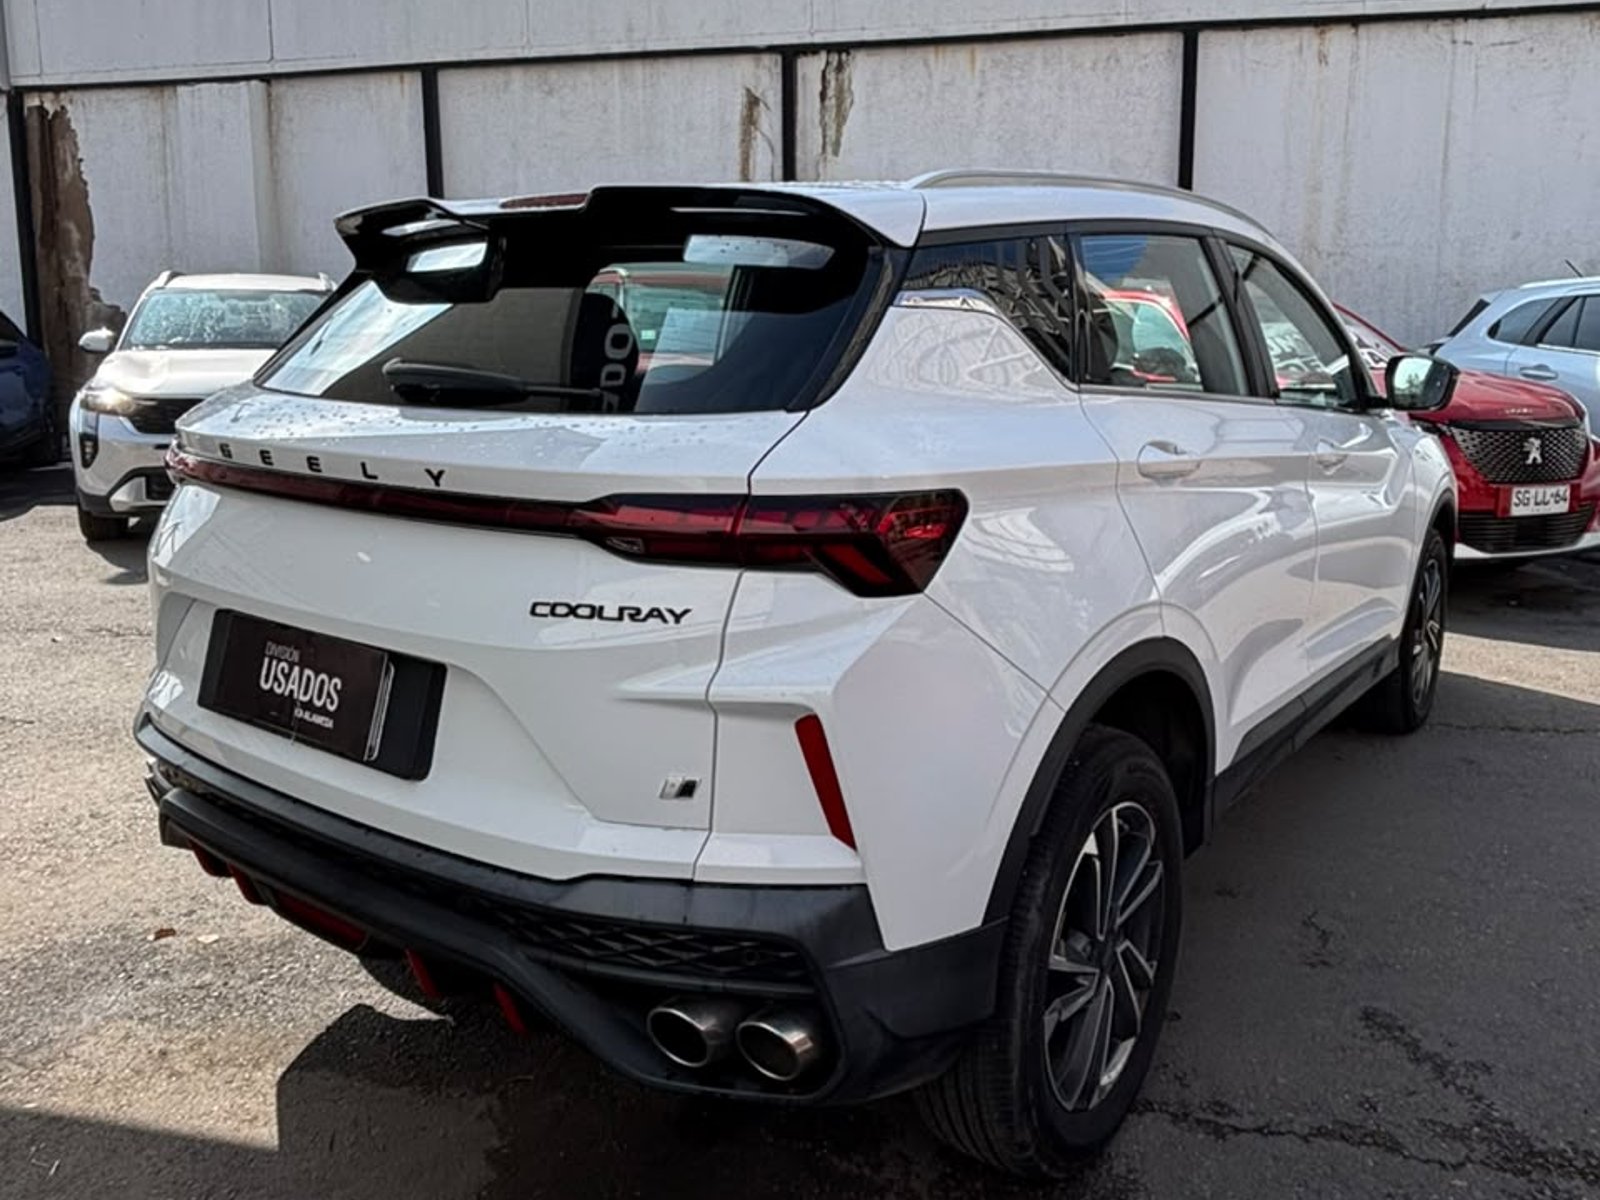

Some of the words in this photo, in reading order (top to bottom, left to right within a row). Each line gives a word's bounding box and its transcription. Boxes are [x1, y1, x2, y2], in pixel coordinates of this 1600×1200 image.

[219, 443, 445, 487] GEELY
[529, 602, 693, 625] COOLRAY
[260, 656, 342, 712] USADOS
